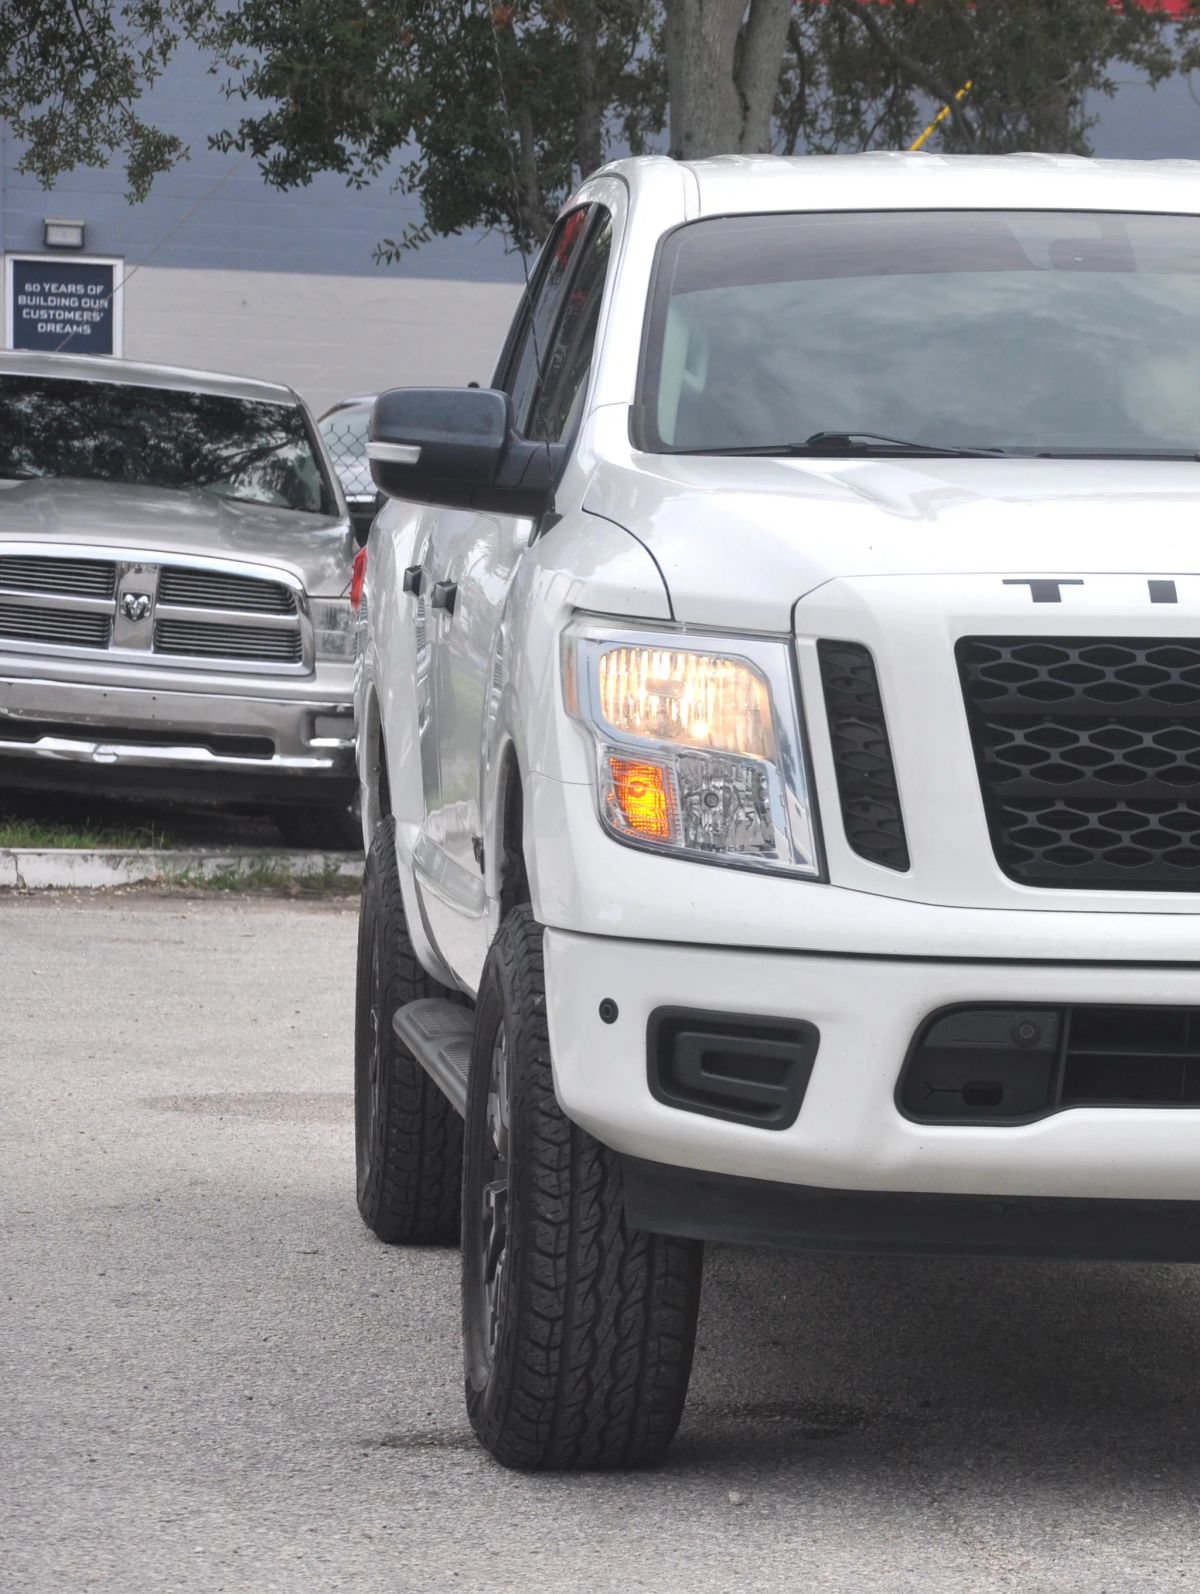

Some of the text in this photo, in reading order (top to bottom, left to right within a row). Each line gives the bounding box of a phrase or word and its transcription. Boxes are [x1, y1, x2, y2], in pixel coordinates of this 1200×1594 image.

[43, 283, 85, 294] YEARS
[87, 285, 104, 295] OF
[18, 295, 108, 309] BUILDING OUR
[22, 308, 104, 322] CUSTOMERS'
[37, 322, 91, 335] DREAMS
